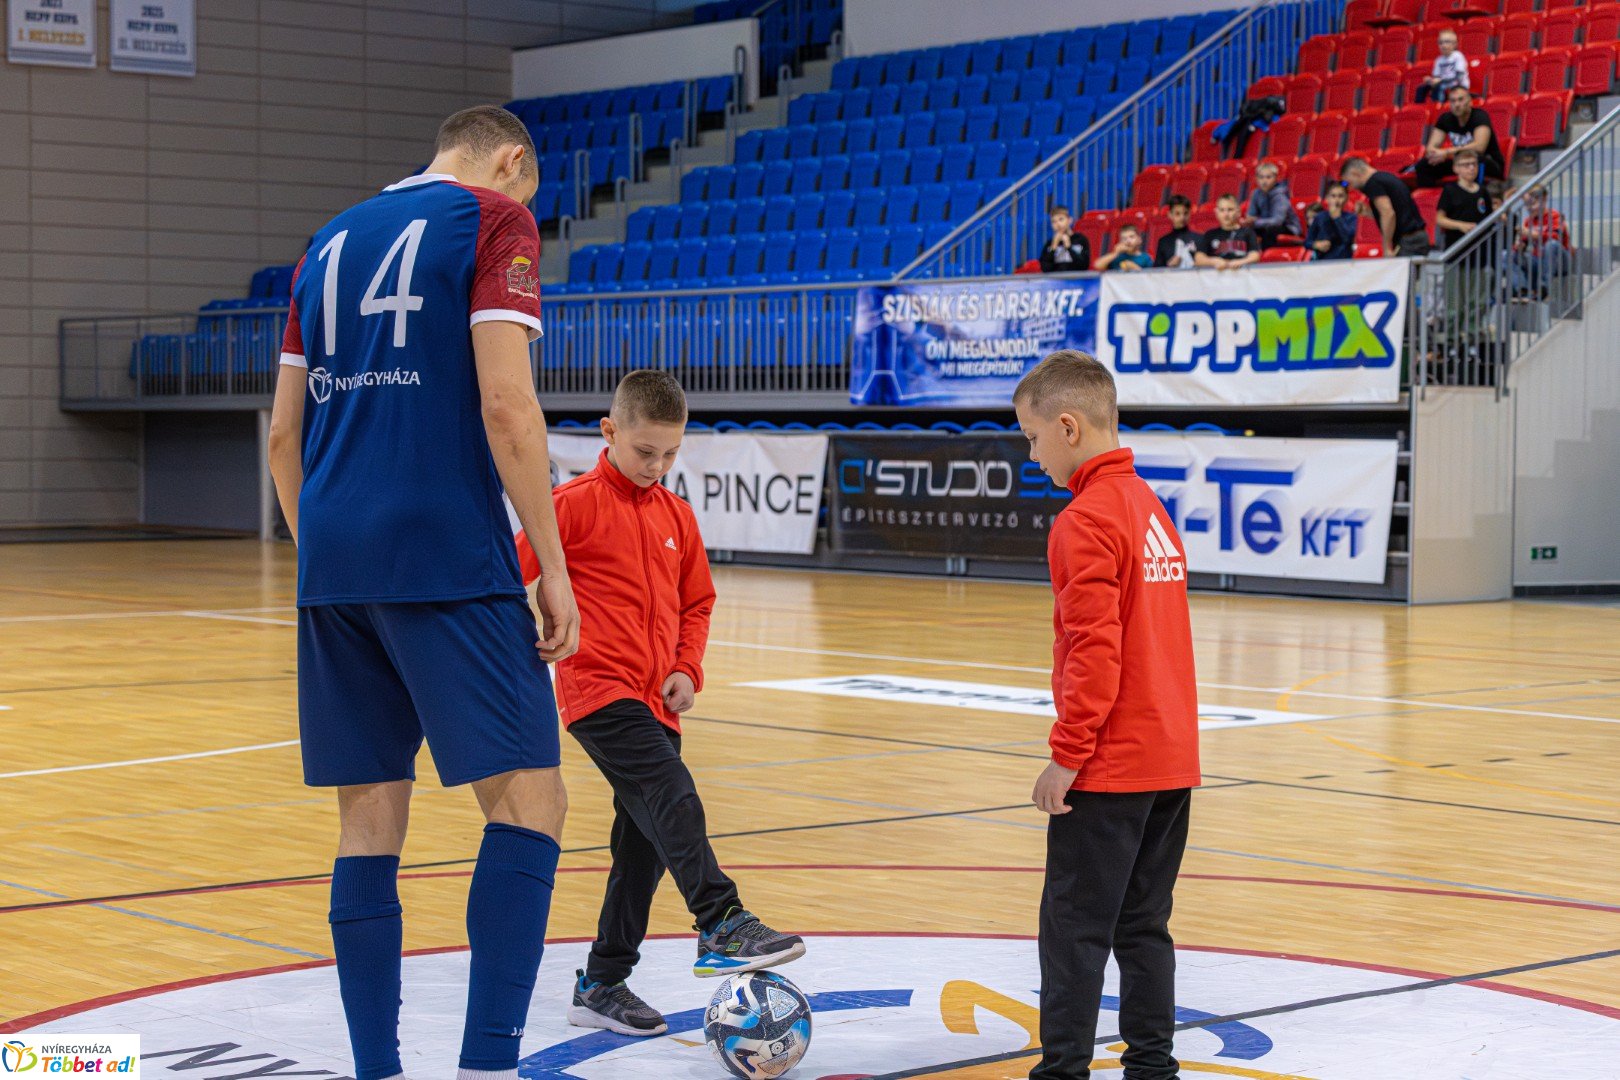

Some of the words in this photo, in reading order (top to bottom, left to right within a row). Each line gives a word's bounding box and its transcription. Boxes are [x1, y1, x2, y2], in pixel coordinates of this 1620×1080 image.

[318, 219, 427, 356] 14
[956, 288, 980, 321] ÉS
[985, 286, 1040, 320] TÁRSA
[1043, 288, 1084, 318] KFT.
[335, 367, 421, 391] NYÍREGYHÁZA
[704, 472, 814, 515] PINCE
[1301, 510, 1368, 559] KFT
[1143, 556, 1185, 583] adida
